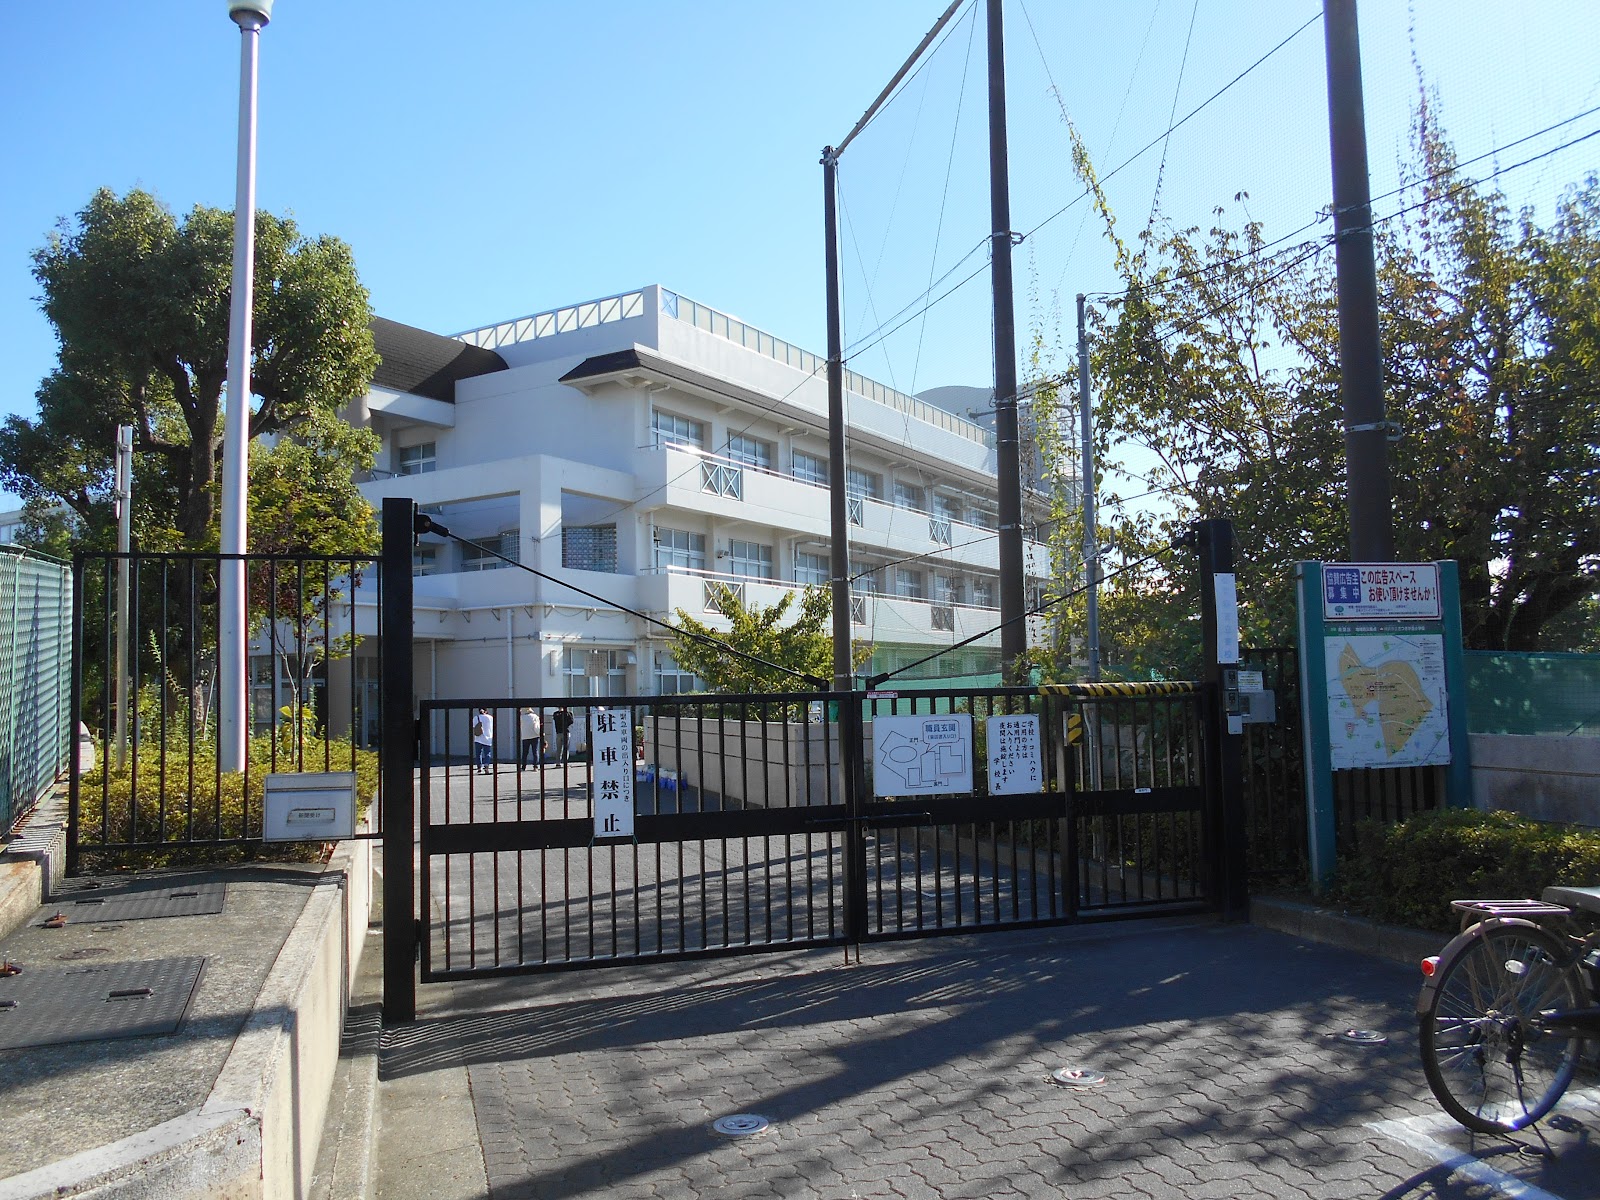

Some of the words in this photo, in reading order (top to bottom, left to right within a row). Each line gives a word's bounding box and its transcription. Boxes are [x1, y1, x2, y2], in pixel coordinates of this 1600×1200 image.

[1361, 569, 1416, 585] この広告スペース
[925, 723, 956, 733] 職員玄関
[1020, 721, 1028, 759] ご用の方は
[1006, 722, 1015, 774] お入りください
[597, 713, 620, 833] 駐車禁止
[993, 757, 1001, 791] 学校長
